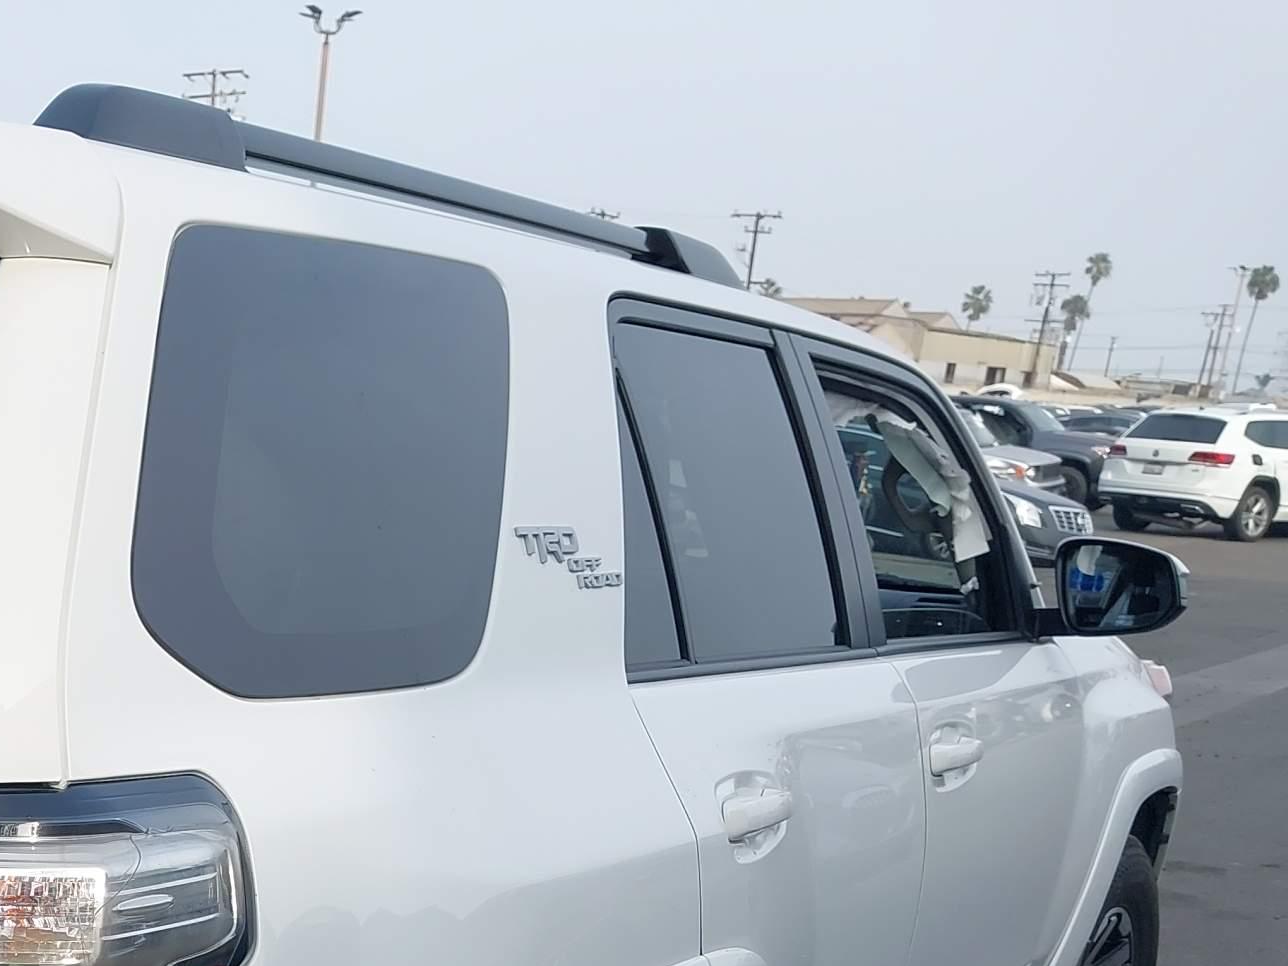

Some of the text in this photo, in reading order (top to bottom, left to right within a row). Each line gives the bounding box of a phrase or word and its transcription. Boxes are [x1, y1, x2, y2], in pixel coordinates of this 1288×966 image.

[514, 527, 579, 564] TRD
[567, 557, 601, 573] OFF
[576, 572, 622, 590] ROAD
